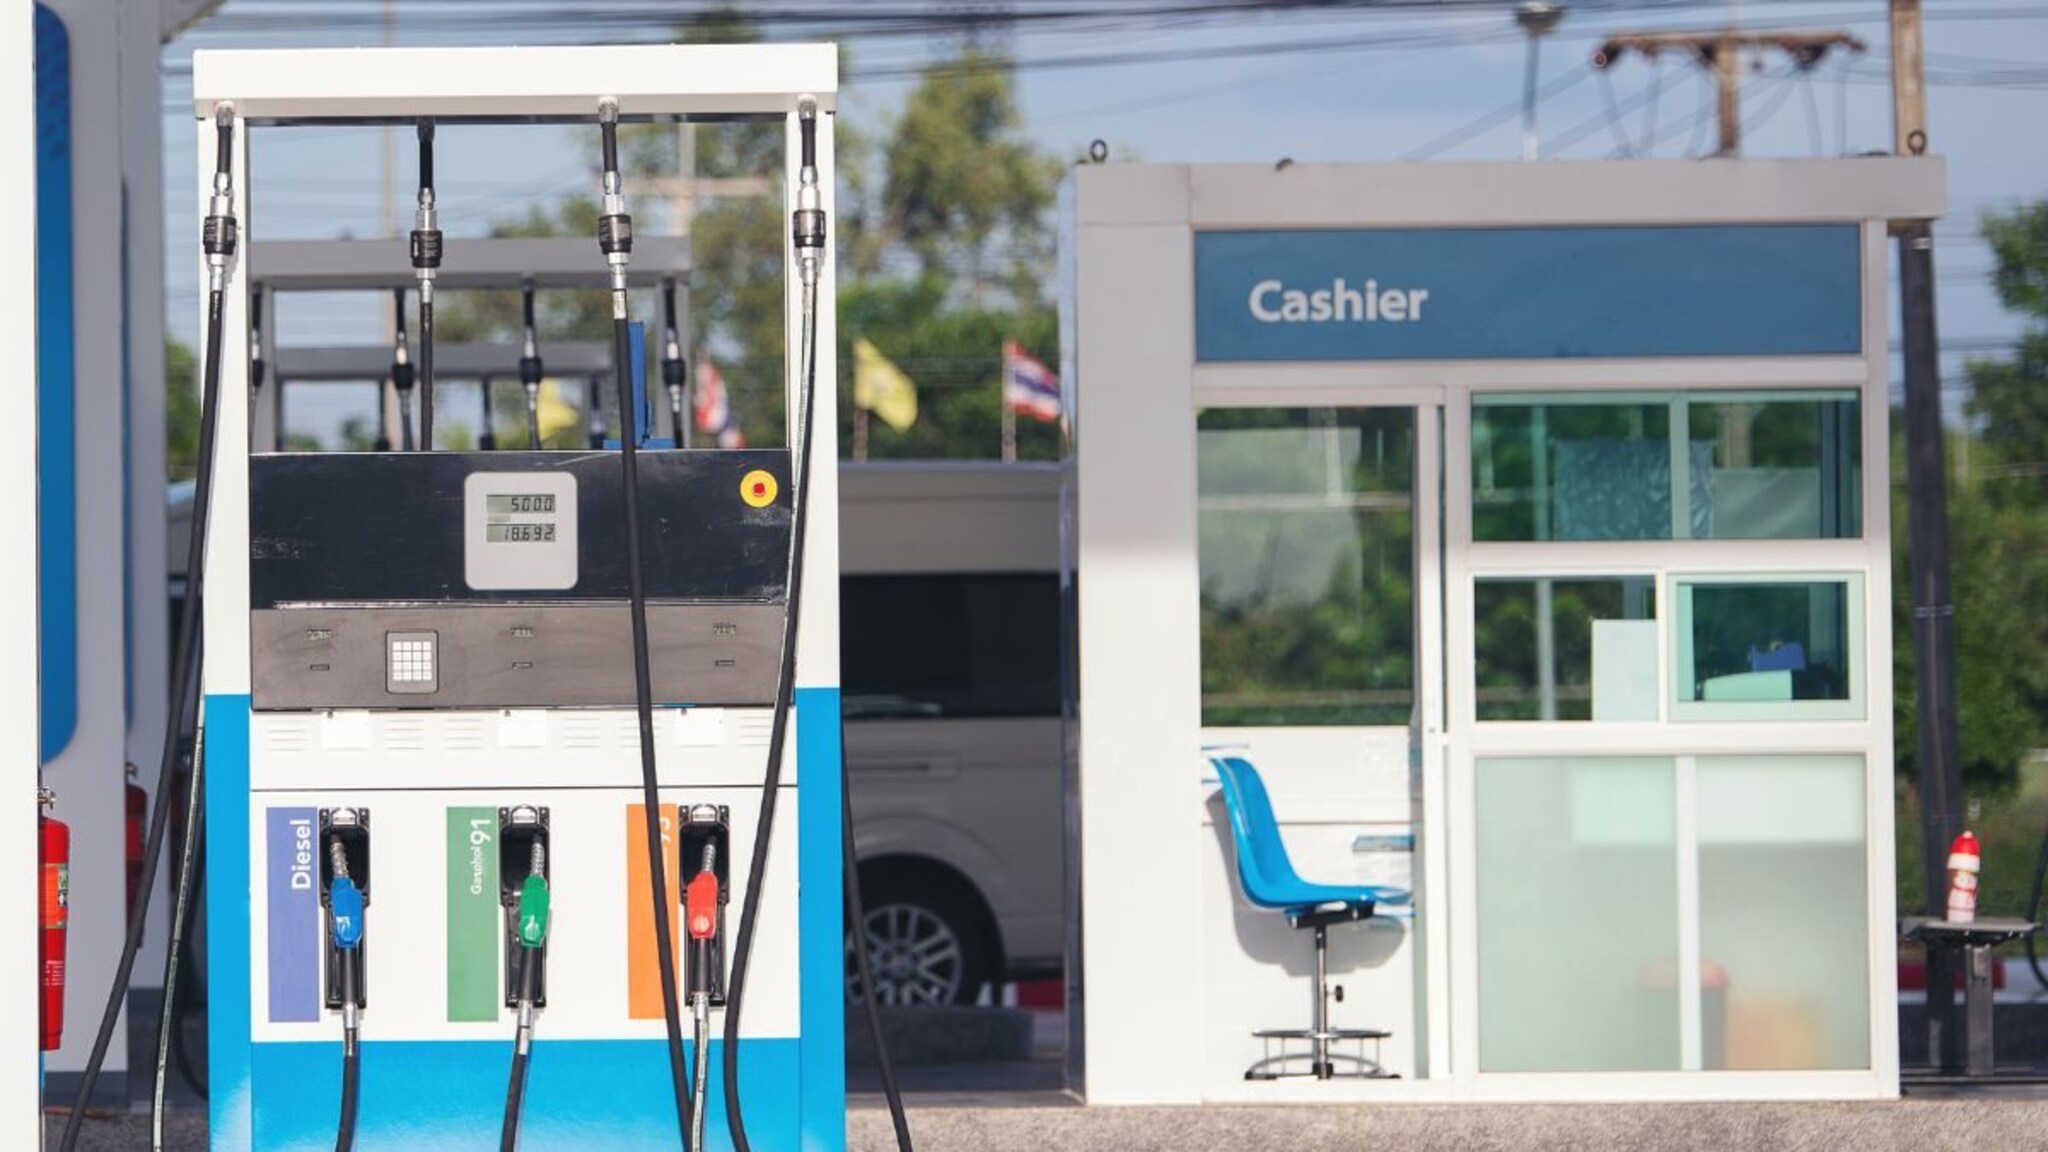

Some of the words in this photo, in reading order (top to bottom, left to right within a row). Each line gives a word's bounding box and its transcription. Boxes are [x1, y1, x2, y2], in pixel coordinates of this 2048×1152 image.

[1249, 278, 1429, 322] Cashier
[289, 819, 311, 889] Diesel
[470, 819, 491, 845] 91
